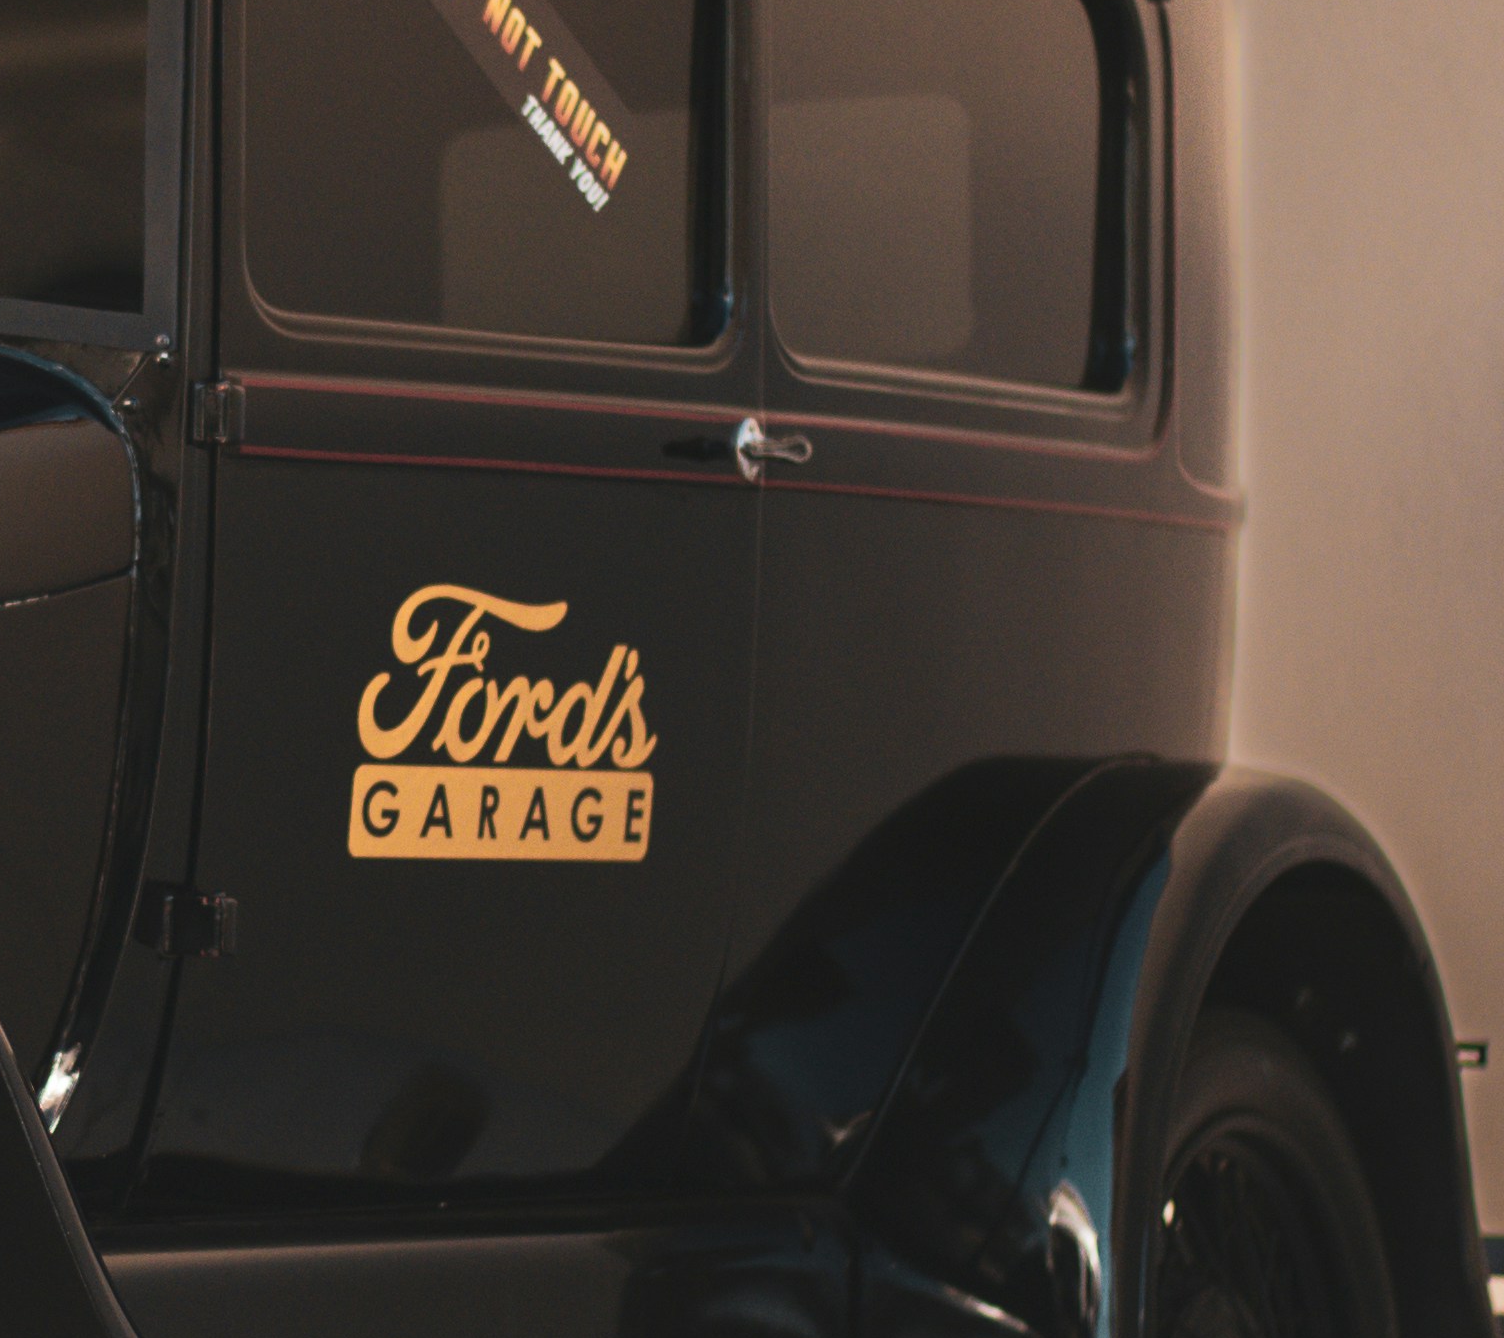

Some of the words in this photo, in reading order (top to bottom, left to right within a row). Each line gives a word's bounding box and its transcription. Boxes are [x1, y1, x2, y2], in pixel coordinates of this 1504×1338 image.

[520, 93, 574, 166] THANK
[568, 157, 610, 213] YOU!
[540, 57, 628, 190] TOUCH
[357, 583, 658, 769] Ford's
[361, 780, 647, 843] GARAGE
